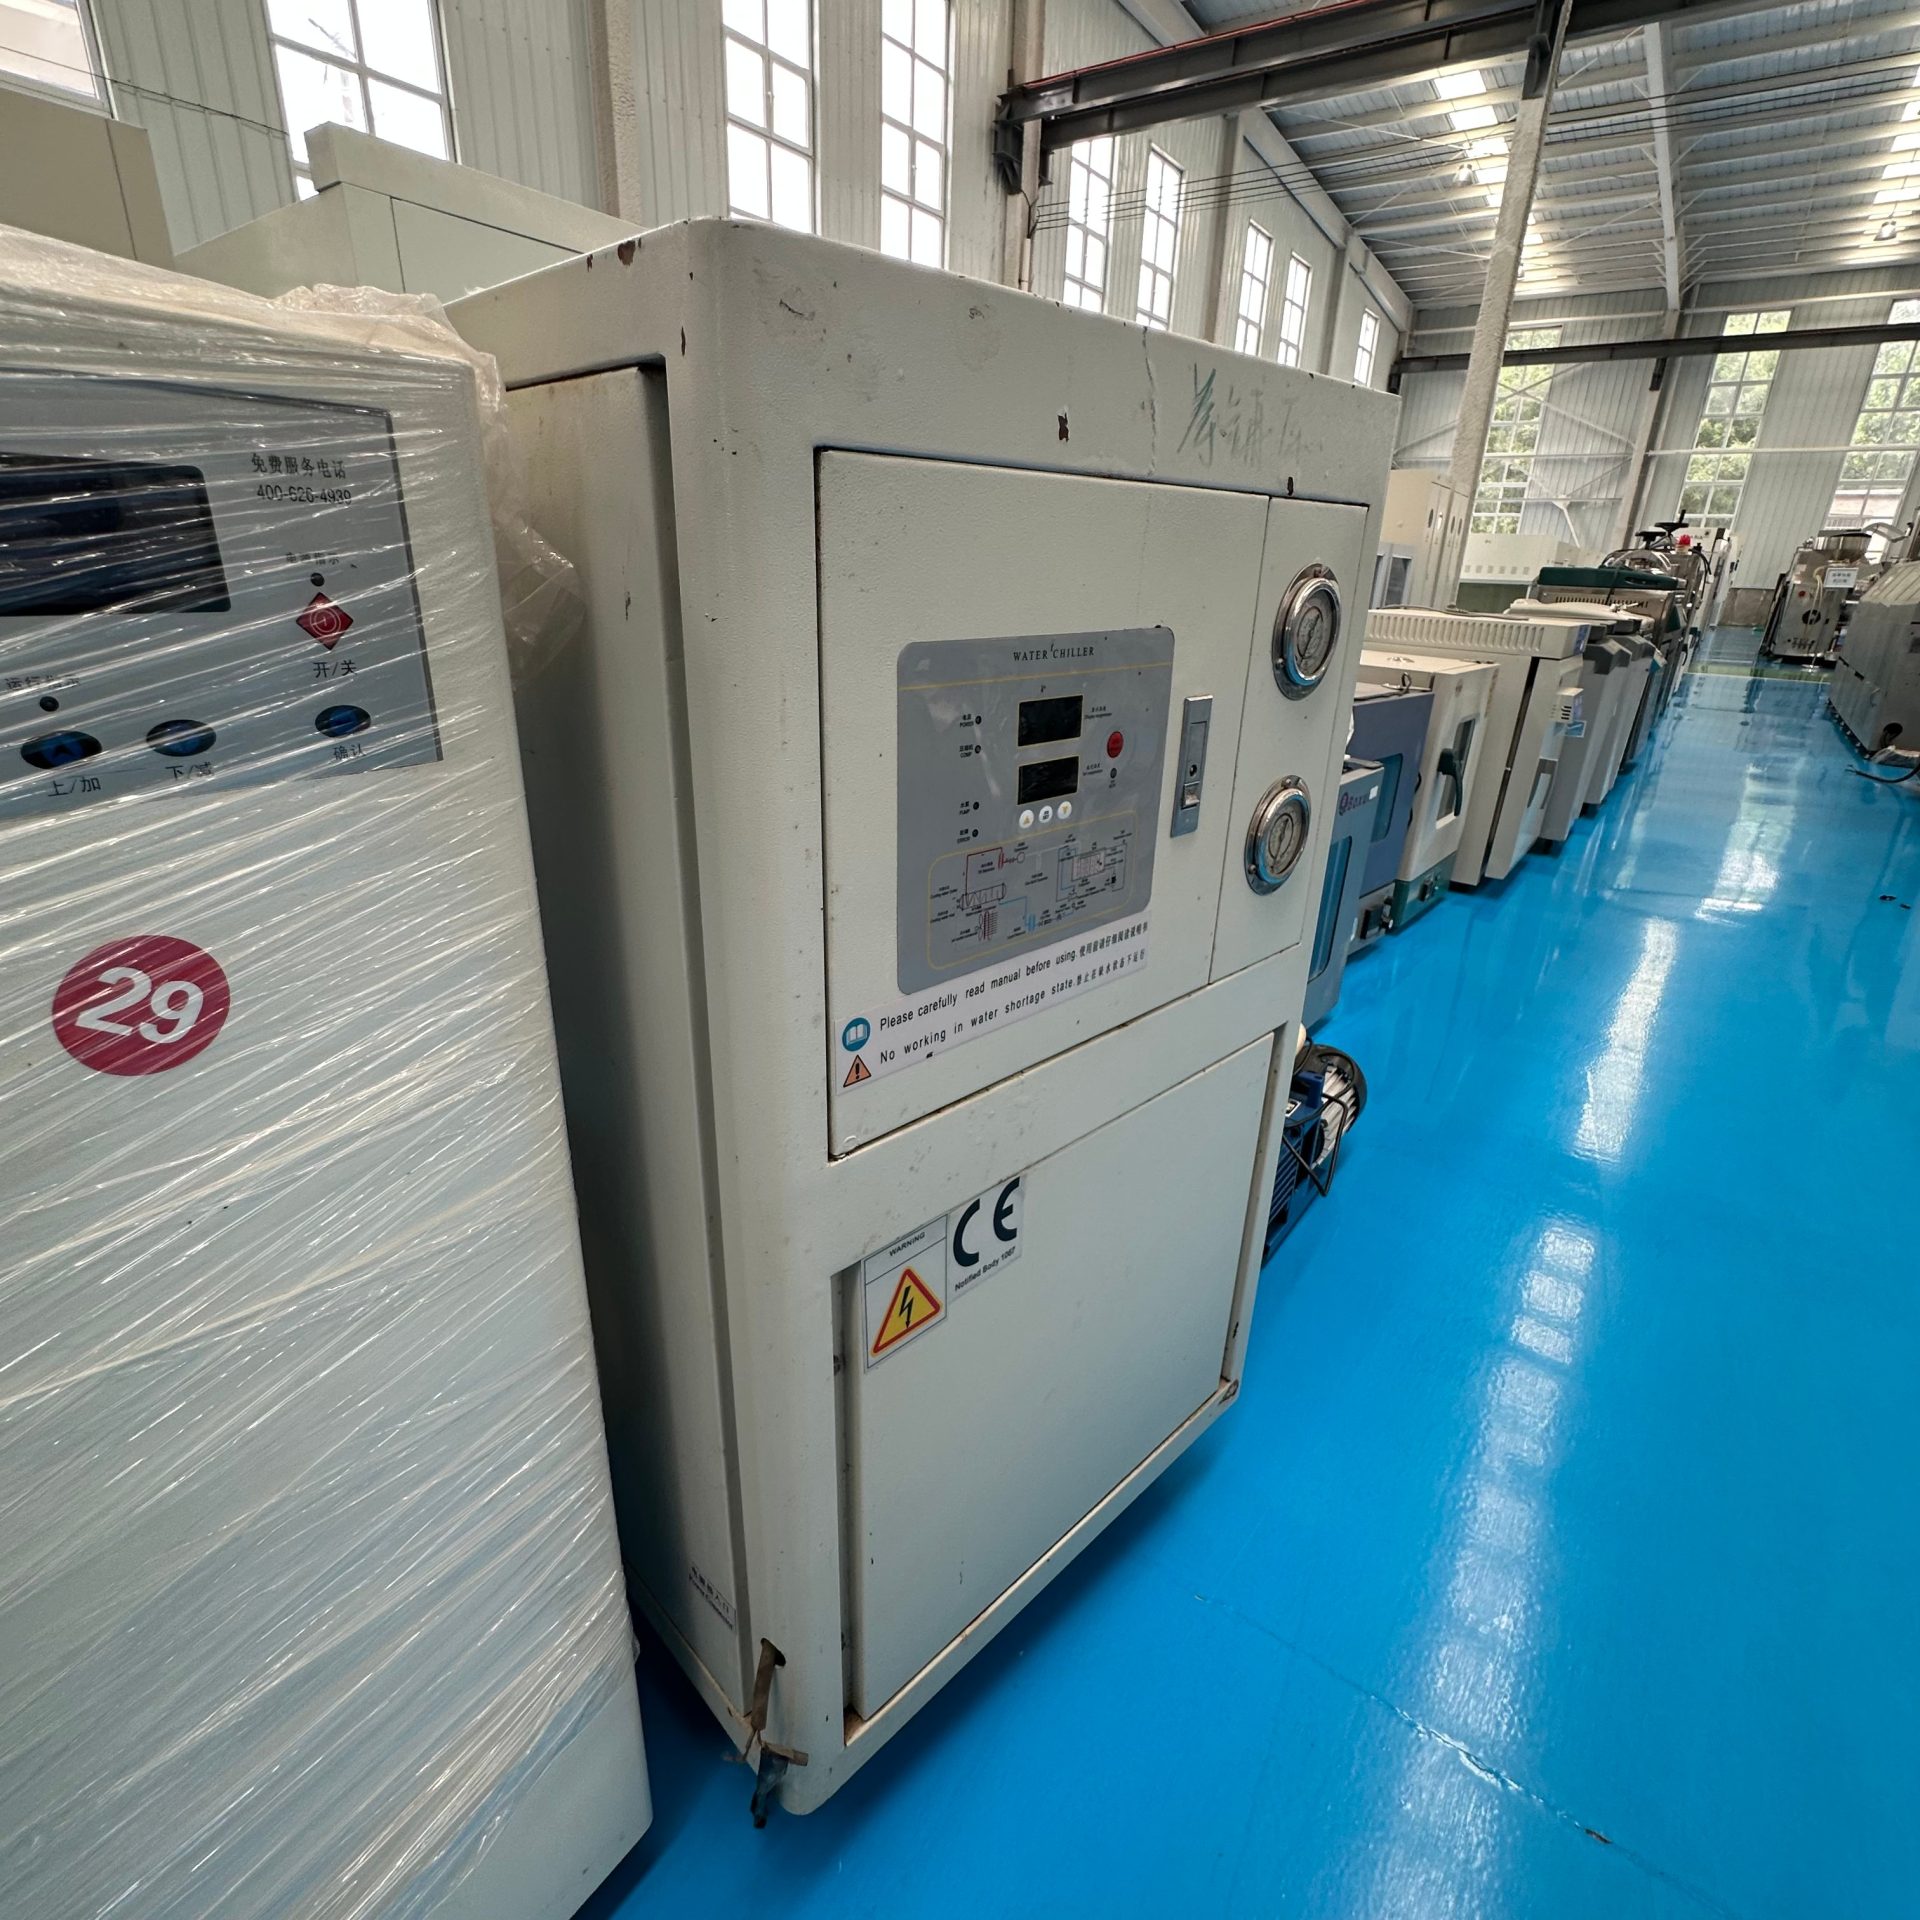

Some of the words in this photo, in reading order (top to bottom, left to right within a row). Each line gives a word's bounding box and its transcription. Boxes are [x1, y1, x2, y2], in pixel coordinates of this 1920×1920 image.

[251, 453, 345, 479] 免费服务电话
[1013, 650, 1048, 661] WATER
[1052, 646, 1095, 659] CHILLER
[313, 659, 357, 678] 开/关
[333, 743, 367, 761] 确认
[47, 775, 101, 797] 上/加
[74, 966, 204, 1044] 29
[880, 1009, 914, 1031] Please
[917, 992, 958, 1017] carefully
[965, 980, 985, 999] read
[990, 968, 1021, 990] manual
[1026, 957, 1051, 977] before
[880, 1050, 895, 1064] No
[904, 1031, 946, 1055] working
[954, 1022, 963, 1034] in
[971, 1007, 998, 1028] water
[1005, 991, 1045, 1014] shortage
[953, 1176, 1020, 1267] CE
[889, 1231, 925, 1257] WARNING
[955, 1268, 981, 1292] Notified
[983, 1258, 999, 1273] Body
